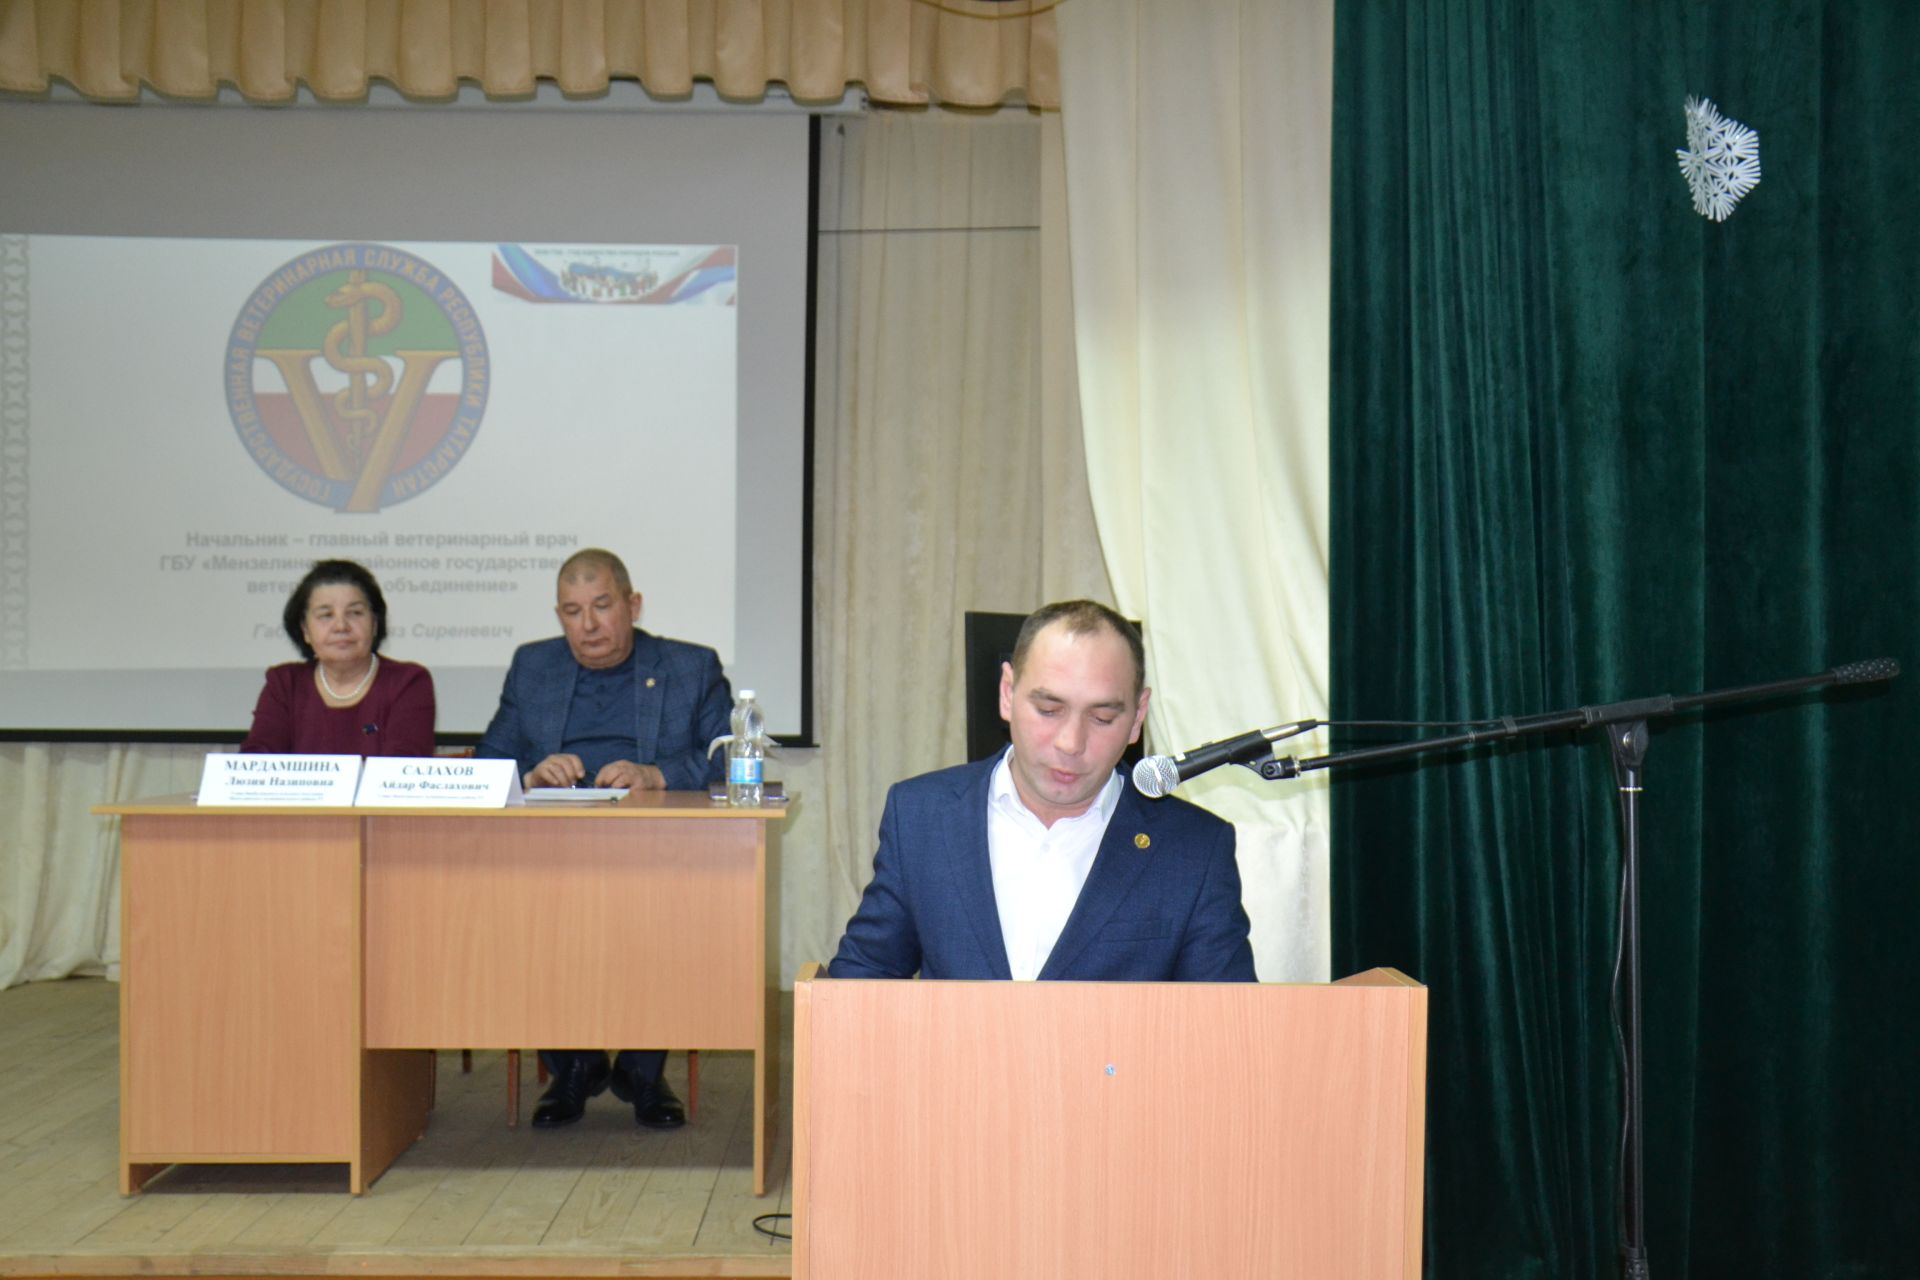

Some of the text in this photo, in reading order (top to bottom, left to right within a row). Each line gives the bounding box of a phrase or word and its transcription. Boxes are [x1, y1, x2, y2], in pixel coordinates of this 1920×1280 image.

[364, 247, 440, 293] СЛУЖБА
[239, 247, 356, 342] ВЕТЕРИНАРНАЯ
[440, 285, 486, 407] РЕСПУБЛИКИ
[391, 415, 476, 498] ТАТАРСТАН
[186, 531, 289, 548] Начальник
[308, 530, 389, 548] главный
[394, 530, 530, 551] ветеринарный
[535, 533, 578, 550] врач
[160, 555, 197, 571] ГБУ
[356, 554, 440, 570] айонное
[383, 577, 518, 595] объединение»
[411, 622, 513, 639] Сиреневич
[224, 759, 341, 773] МАРДАМШИНА
[401, 763, 475, 776] САЛАХОВ
[225, 776, 266, 787] Люзия
[379, 779, 490, 791] Айдар Фаслахович
